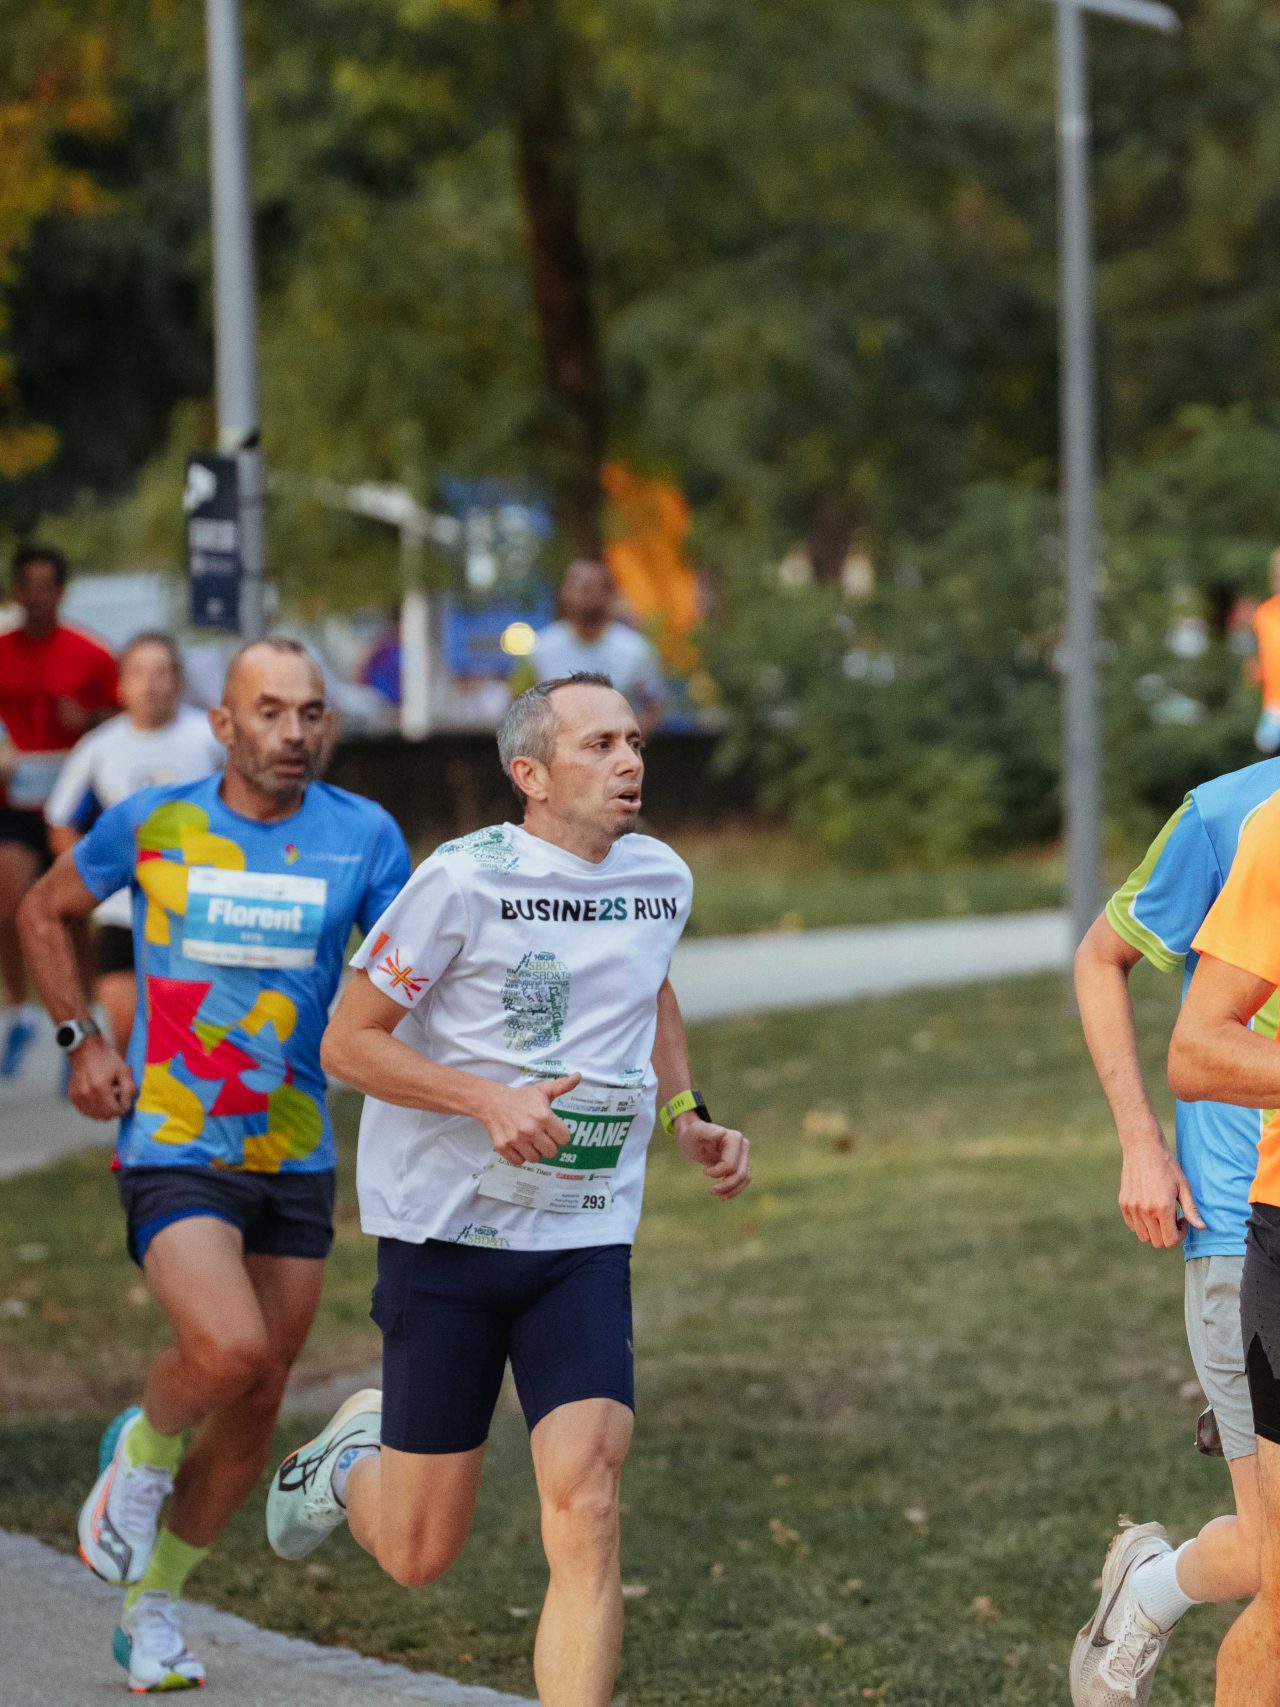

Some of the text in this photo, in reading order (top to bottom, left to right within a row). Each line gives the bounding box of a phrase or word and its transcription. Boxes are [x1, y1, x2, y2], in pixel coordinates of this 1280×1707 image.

[207, 898, 303, 932] Florent
[634, 897, 678, 920] RUN
[562, 1118, 630, 1146] PHANE
[560, 1152, 577, 1163] 293
[581, 1195, 606, 1210] 293
